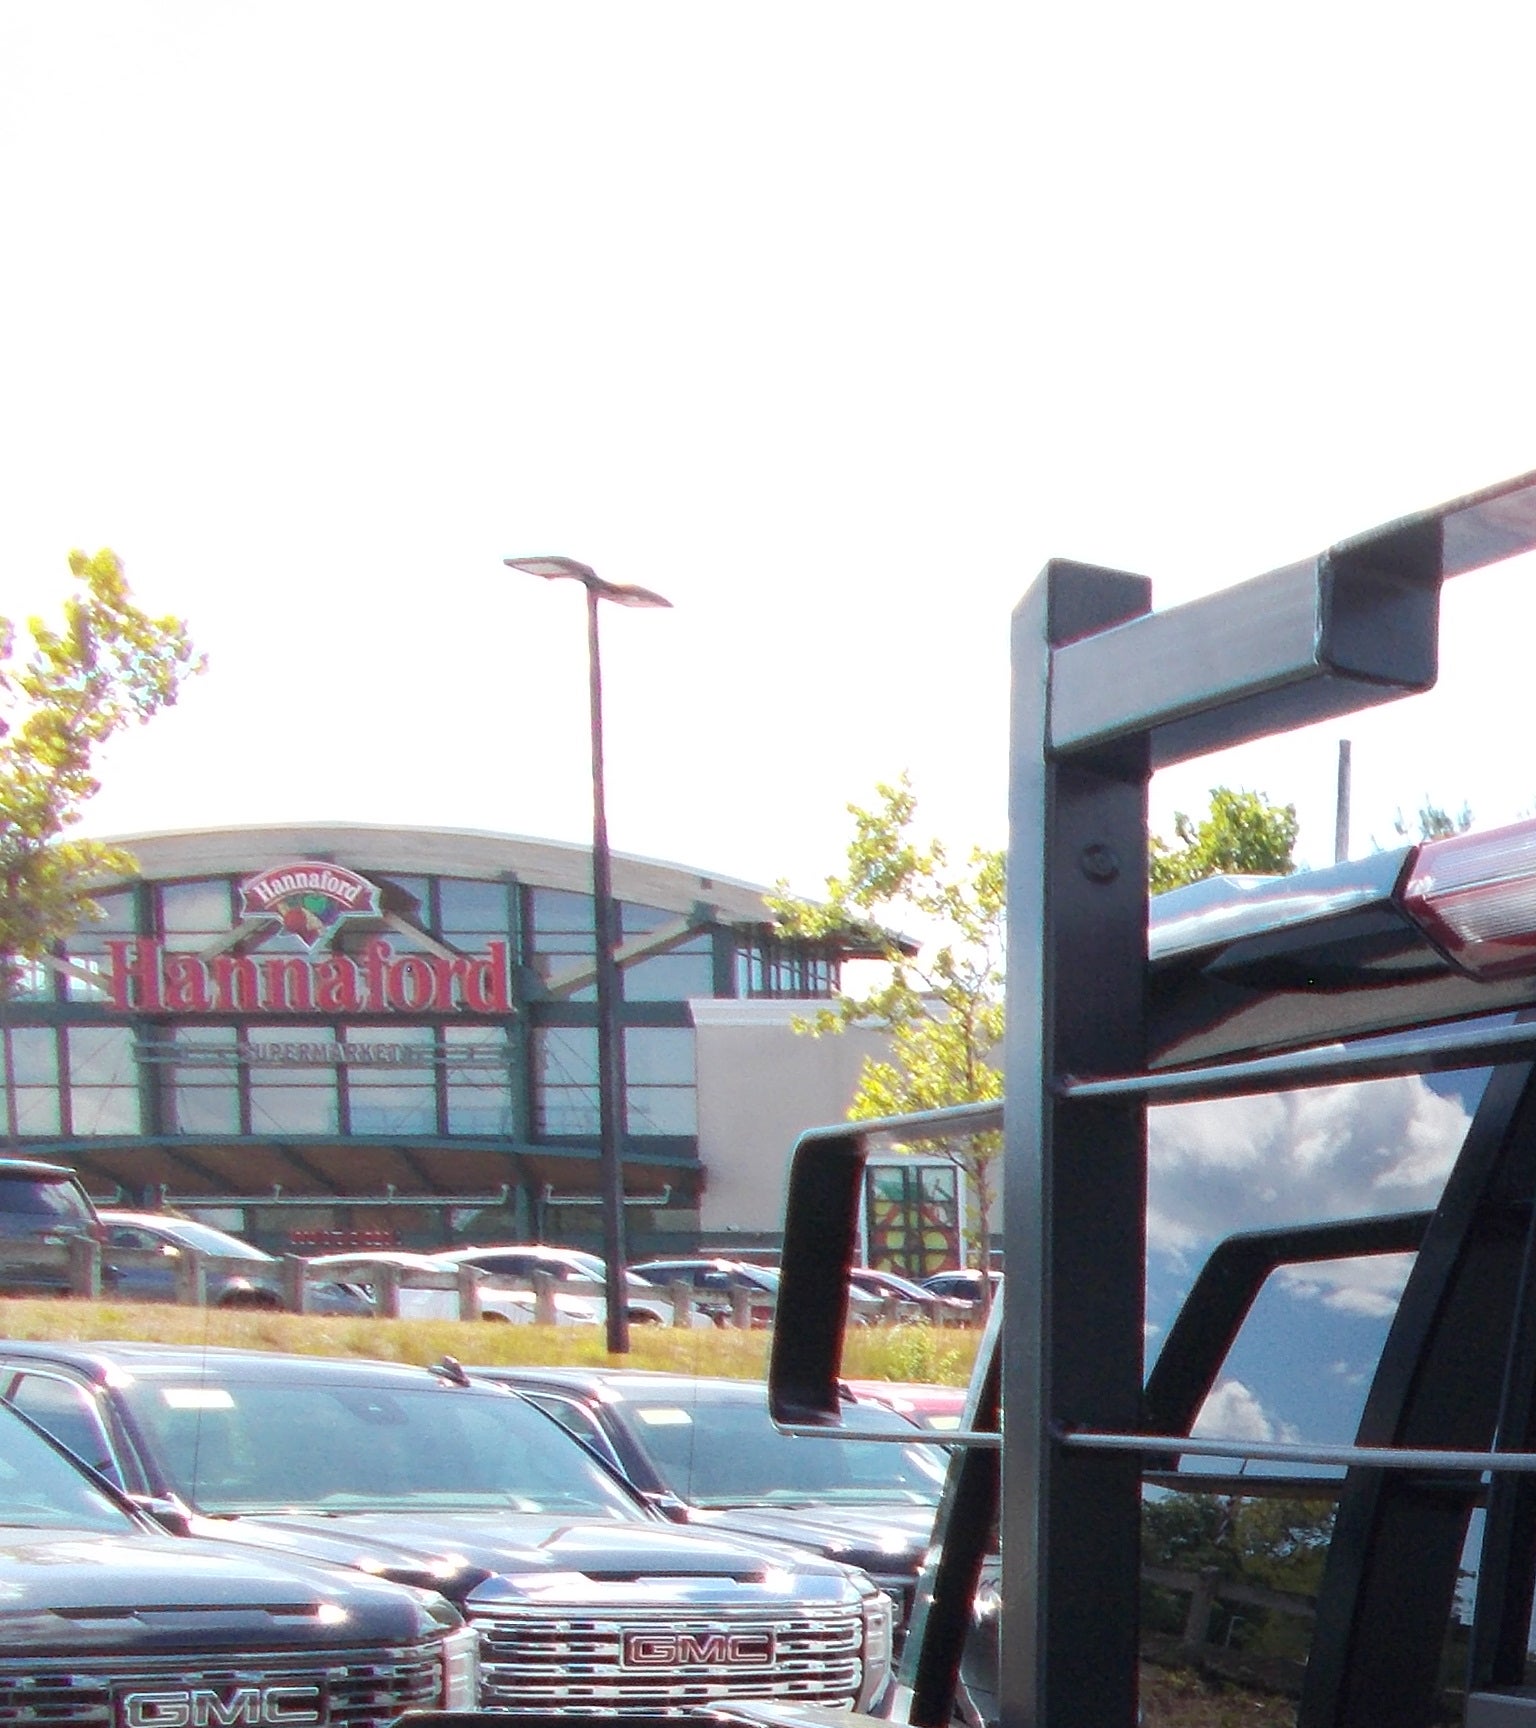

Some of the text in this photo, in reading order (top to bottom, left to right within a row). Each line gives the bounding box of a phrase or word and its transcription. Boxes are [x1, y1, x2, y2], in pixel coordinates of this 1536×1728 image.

[254, 871, 363, 903] Hannaford
[104, 936, 517, 1013] Hannaford
[242, 1042, 404, 1063] SUPERMARKET
[630, 1635, 768, 1663] GMC
[124, 1687, 319, 1728] GMC
